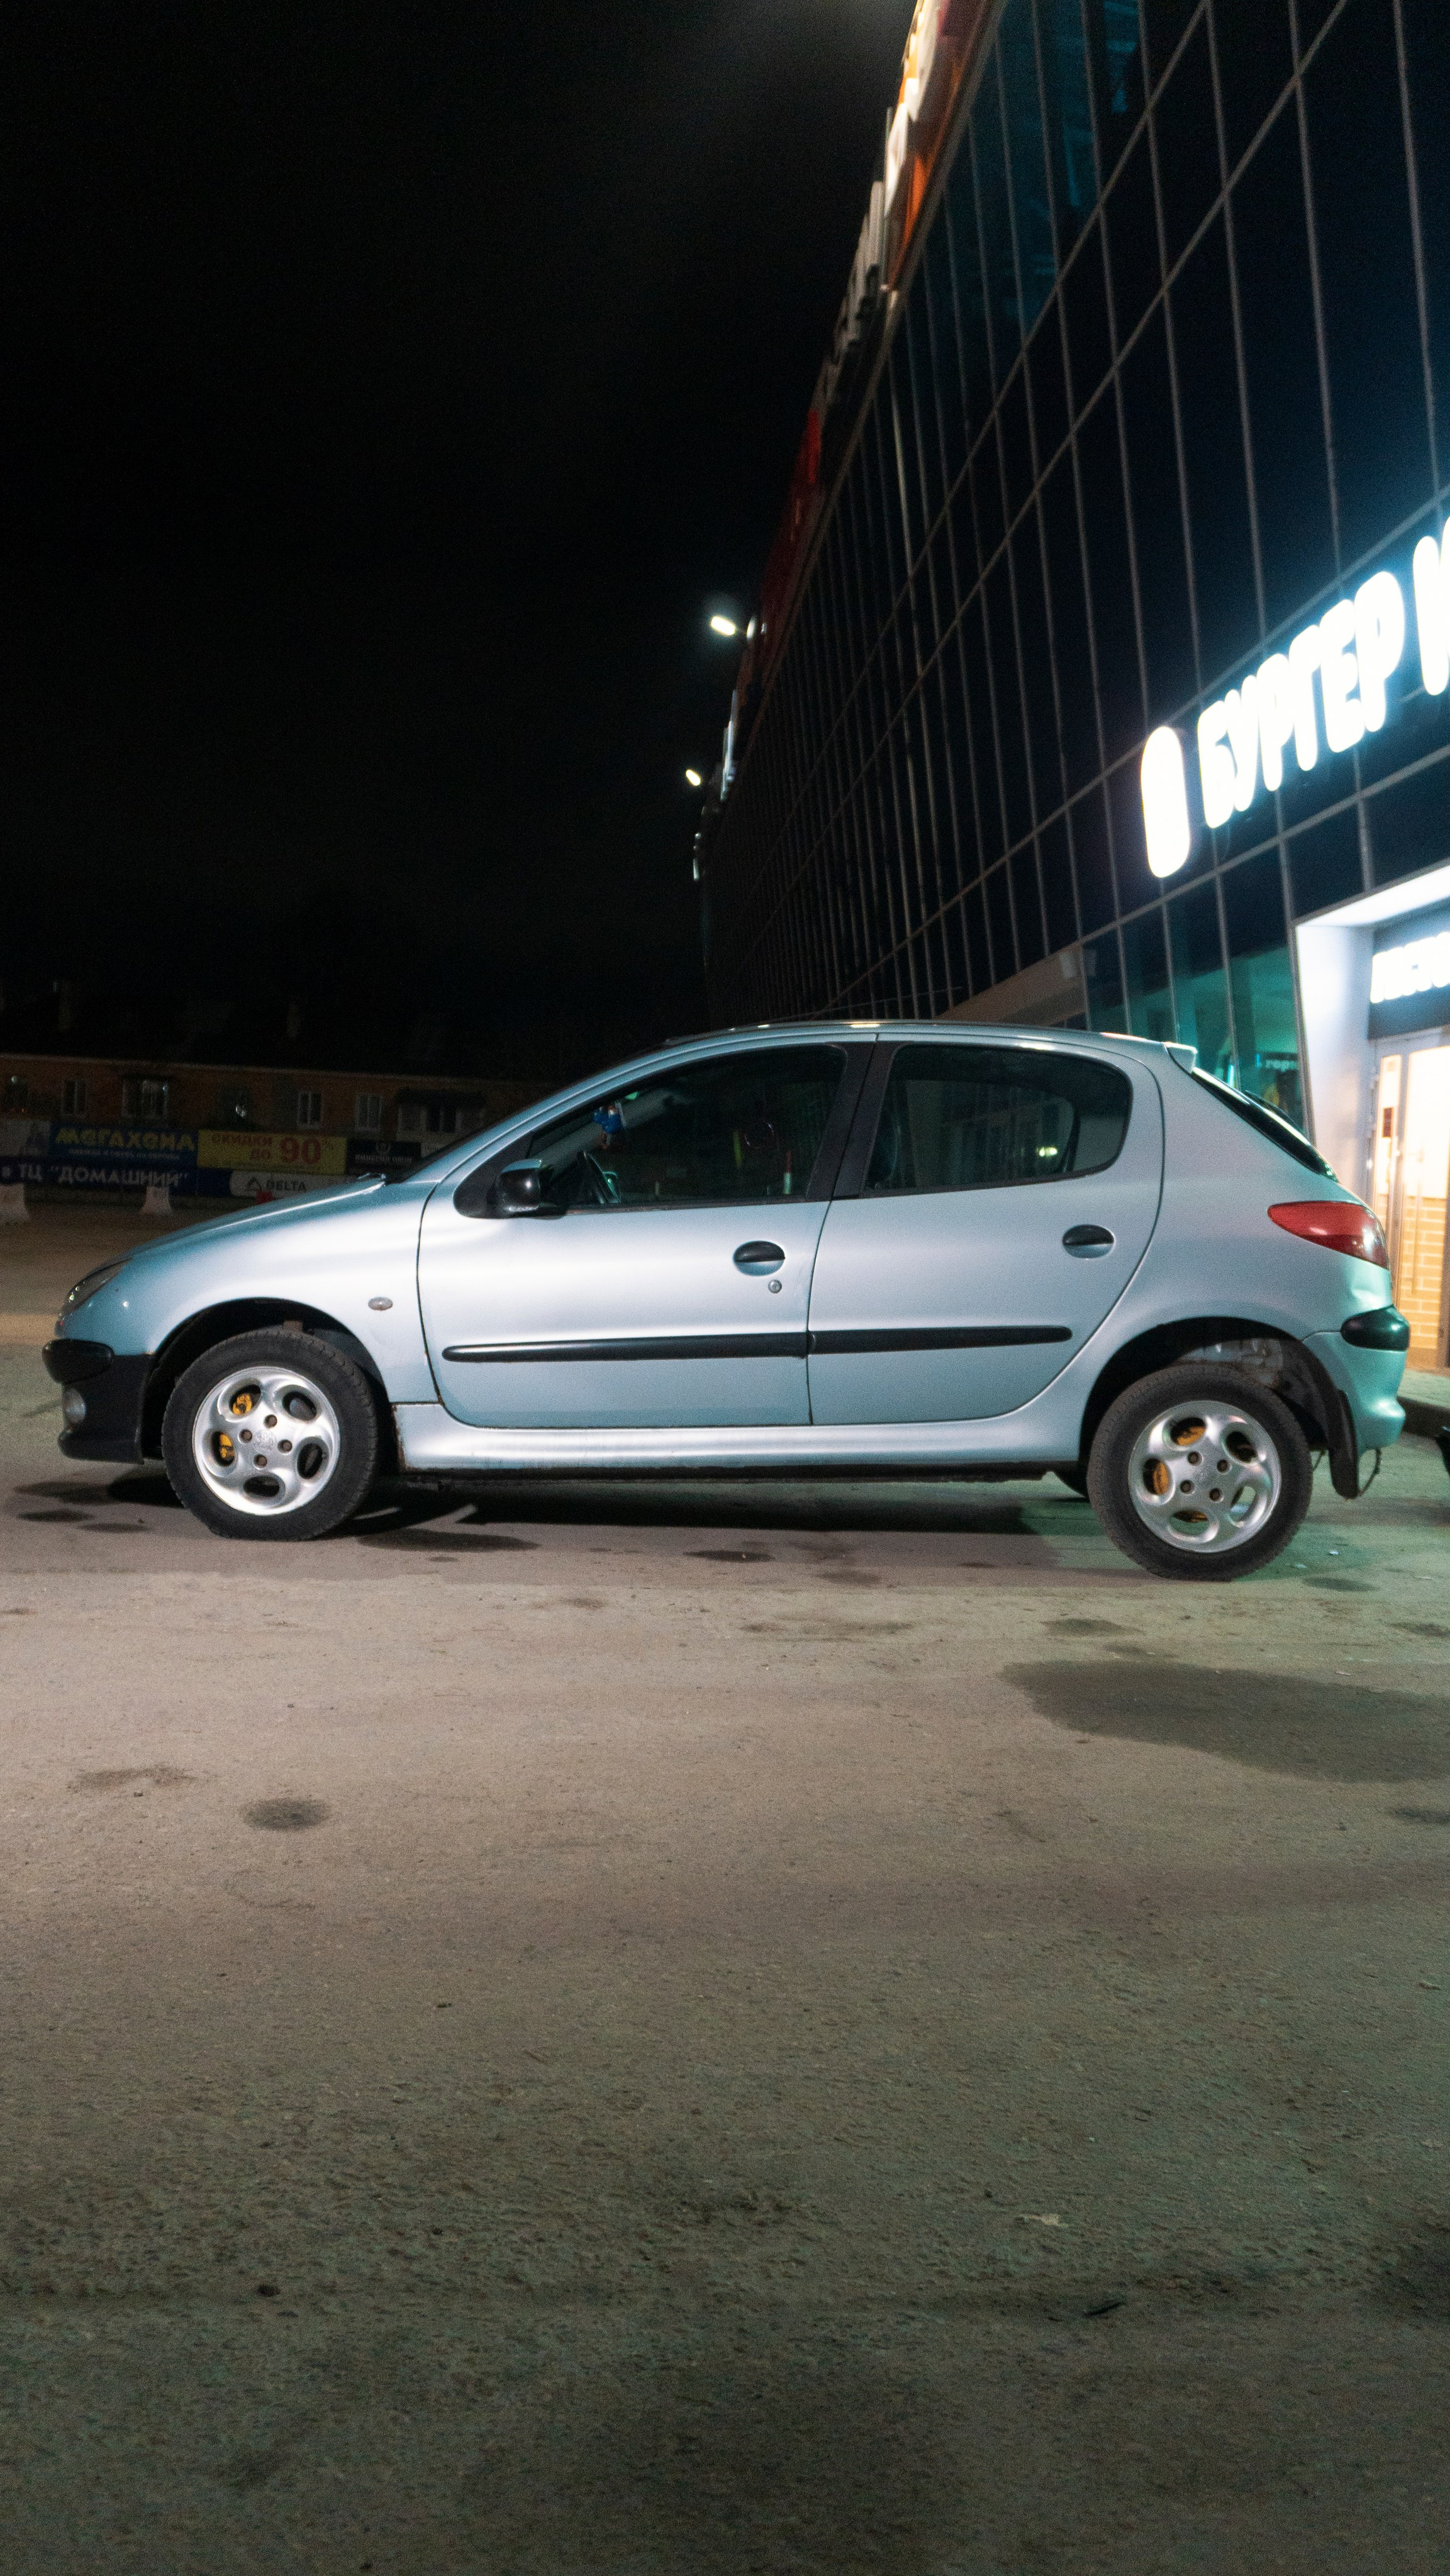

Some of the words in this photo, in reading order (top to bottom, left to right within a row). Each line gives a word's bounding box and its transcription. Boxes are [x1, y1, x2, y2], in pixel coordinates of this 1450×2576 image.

[1198, 571, 1405, 828] БУРГЕР
[17, 1163, 42, 1183] ТЦ
[265, 1179, 306, 1192] DELTA
